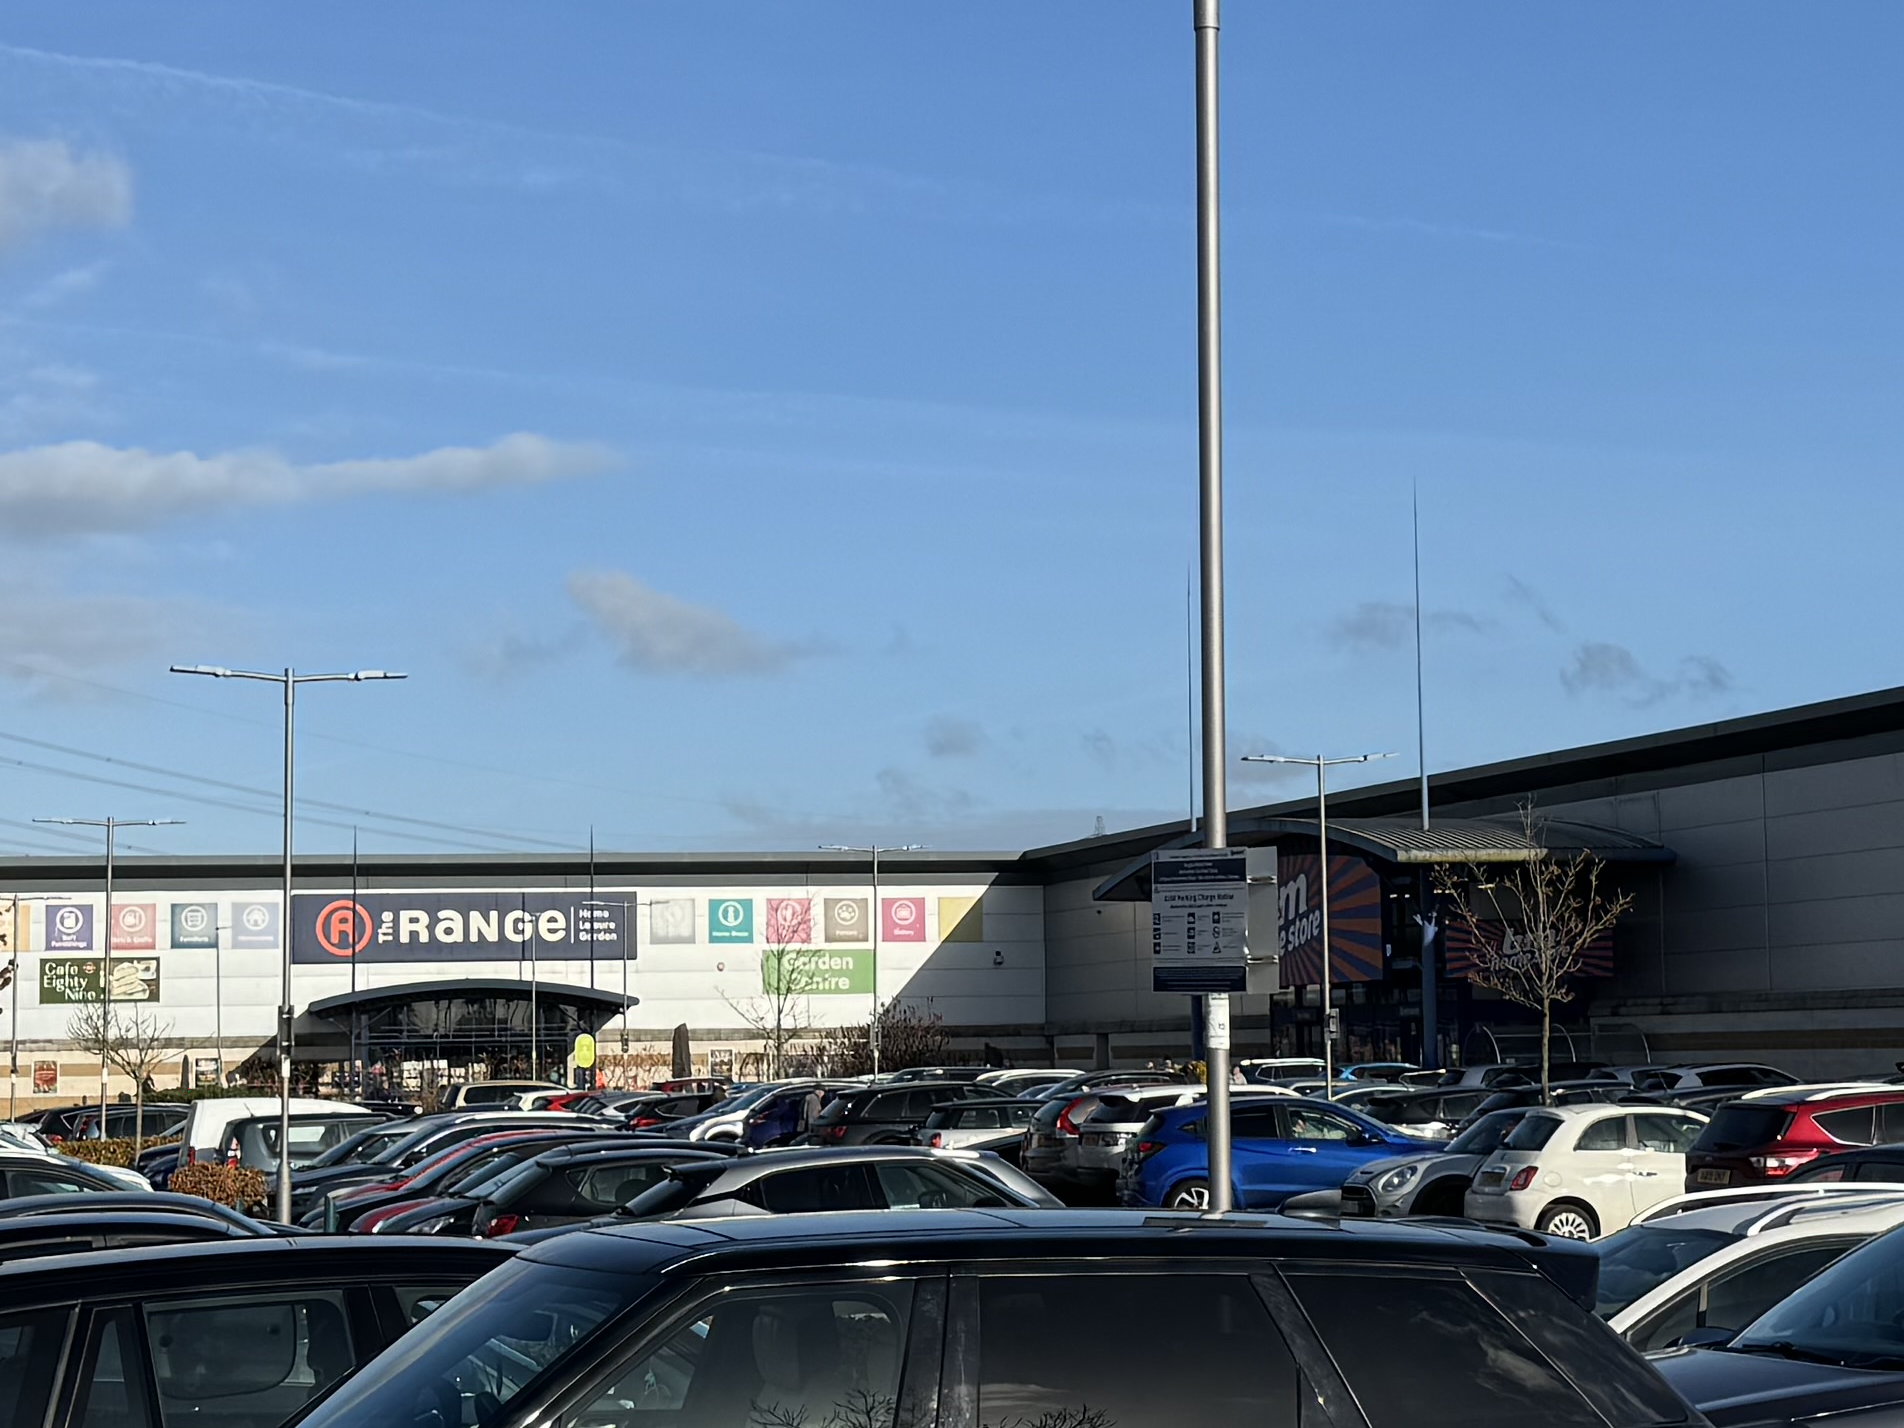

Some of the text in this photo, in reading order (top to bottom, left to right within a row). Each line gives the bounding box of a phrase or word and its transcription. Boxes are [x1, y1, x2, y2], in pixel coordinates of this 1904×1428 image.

[377, 911, 394, 944] The
[579, 920, 616, 930] Lesure
[1287, 909, 1321, 952] store
[45, 961, 78, 975] Cafe
[781, 951, 853, 970] Garden
[43, 974, 88, 992] Eighty
